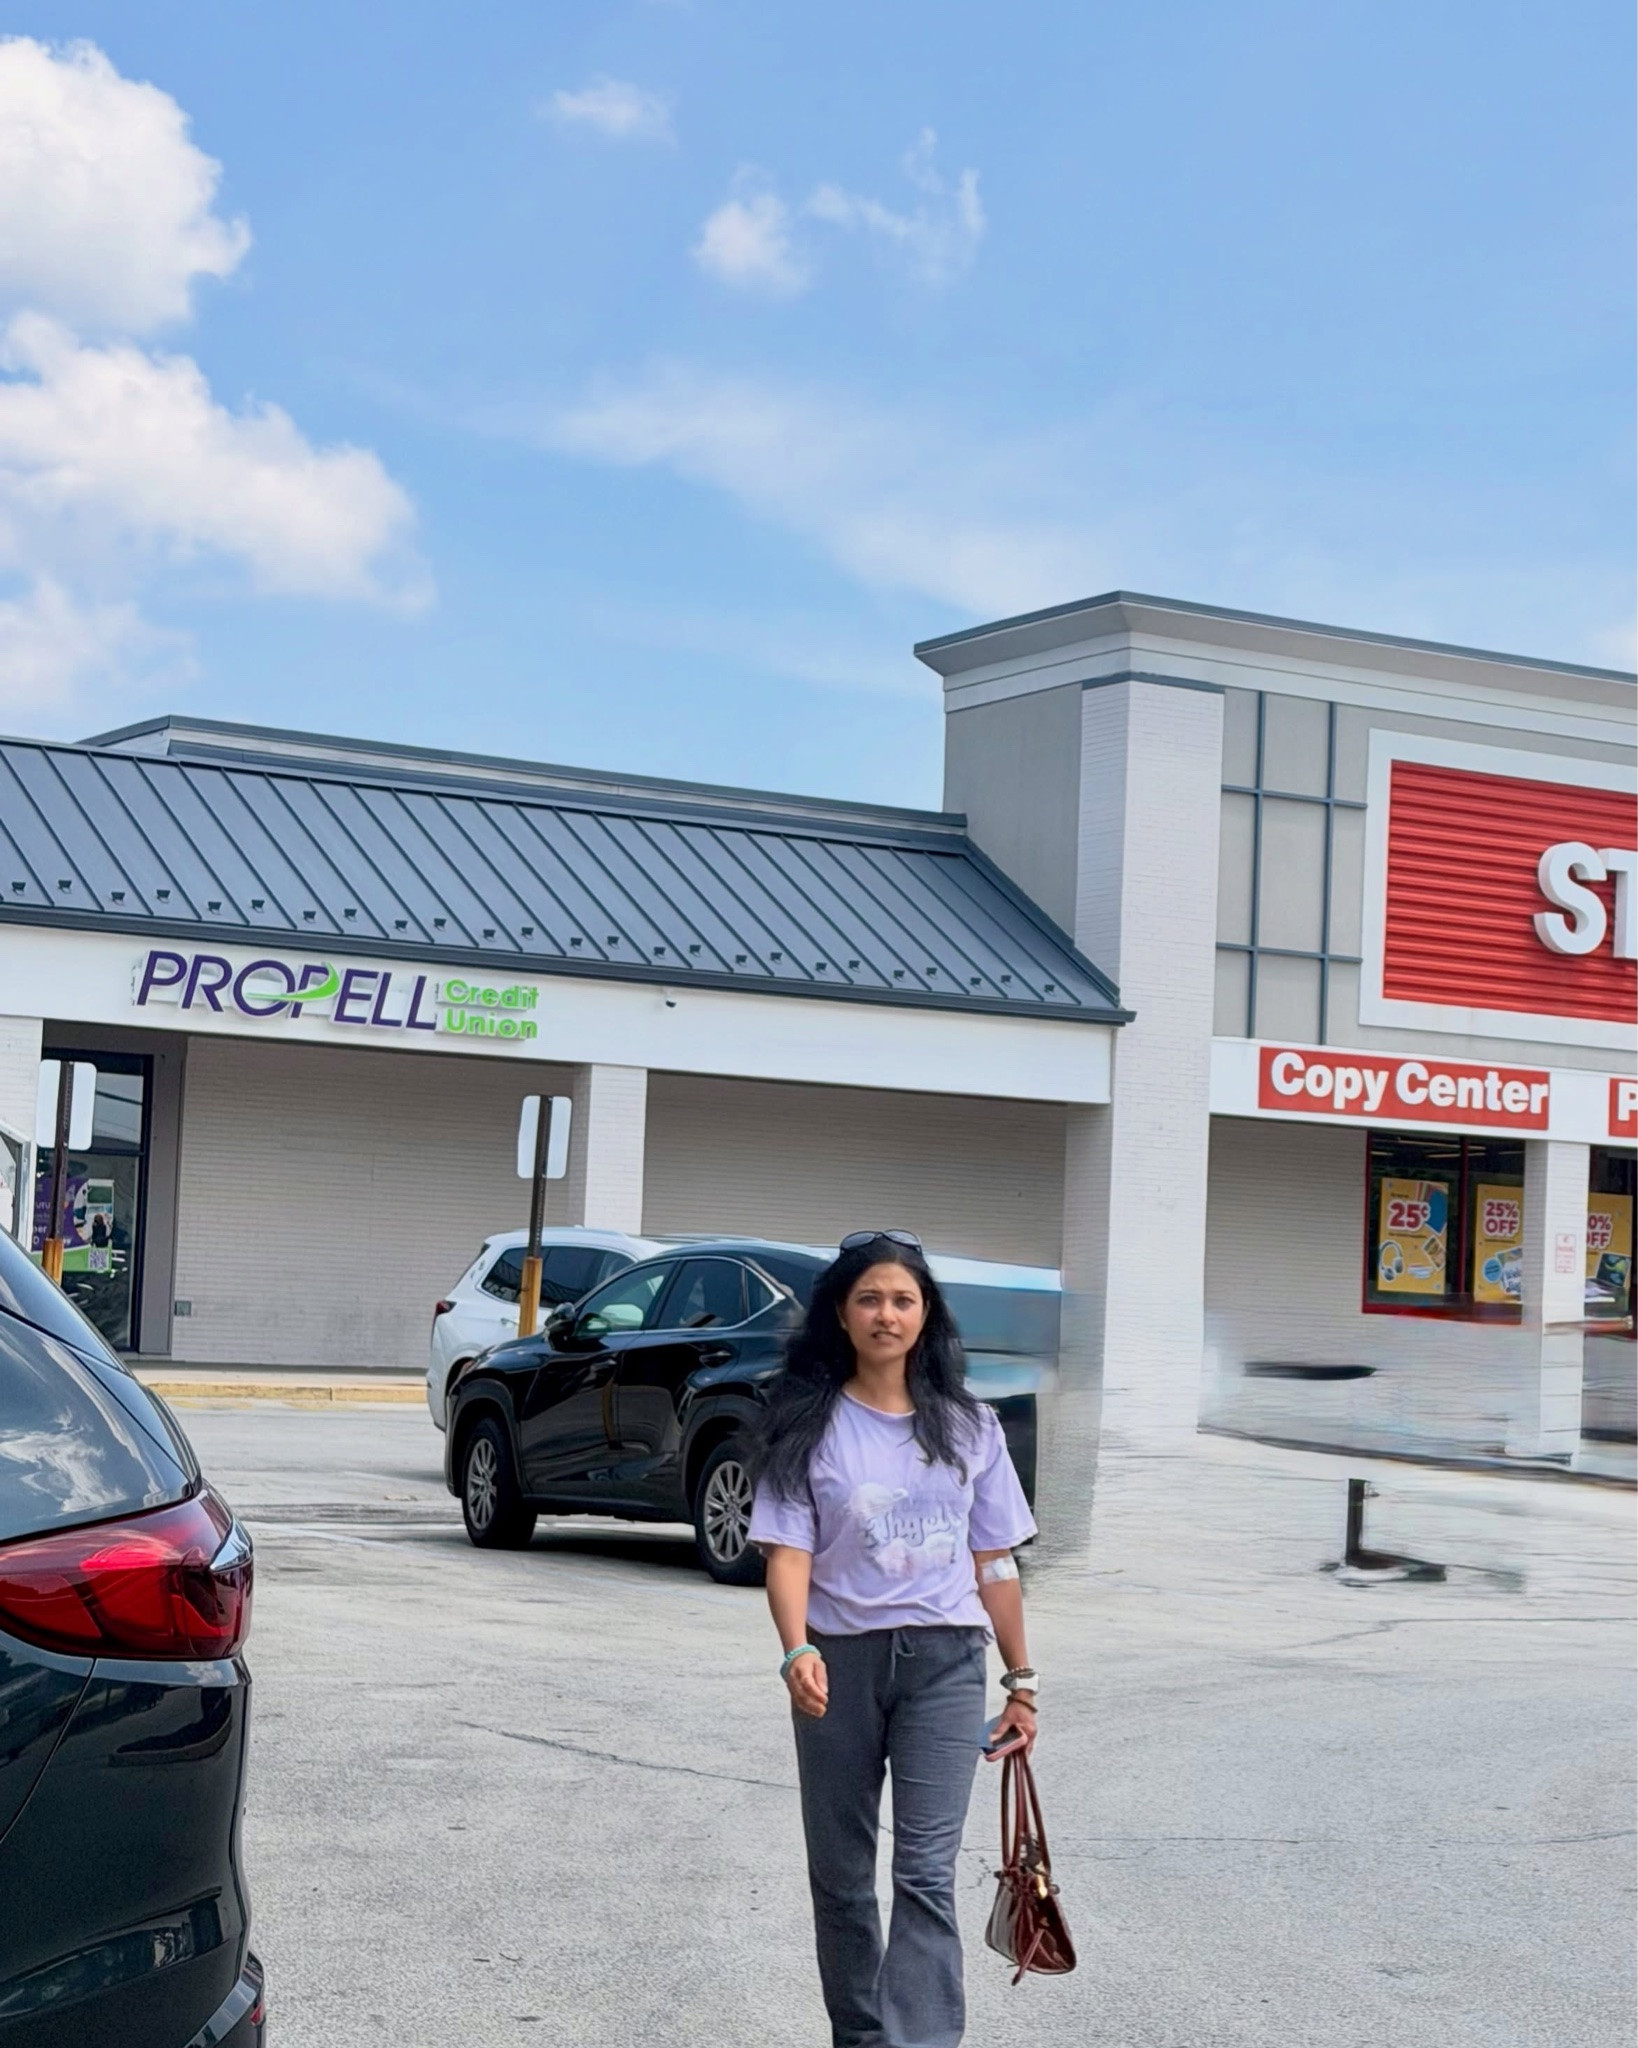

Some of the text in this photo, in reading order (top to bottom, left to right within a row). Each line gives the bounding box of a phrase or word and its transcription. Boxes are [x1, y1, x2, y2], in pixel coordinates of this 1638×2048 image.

[137, 950, 437, 1031] PROPELL
[445, 979, 539, 1010] Credit
[445, 1008, 538, 1039] Union
[1271, 1052, 1549, 1114] Copy Center
[1485, 1201, 1518, 1218] 25%
[1588, 1214, 1611, 1230] 0%
[1485, 1218, 1518, 1233] OFF
